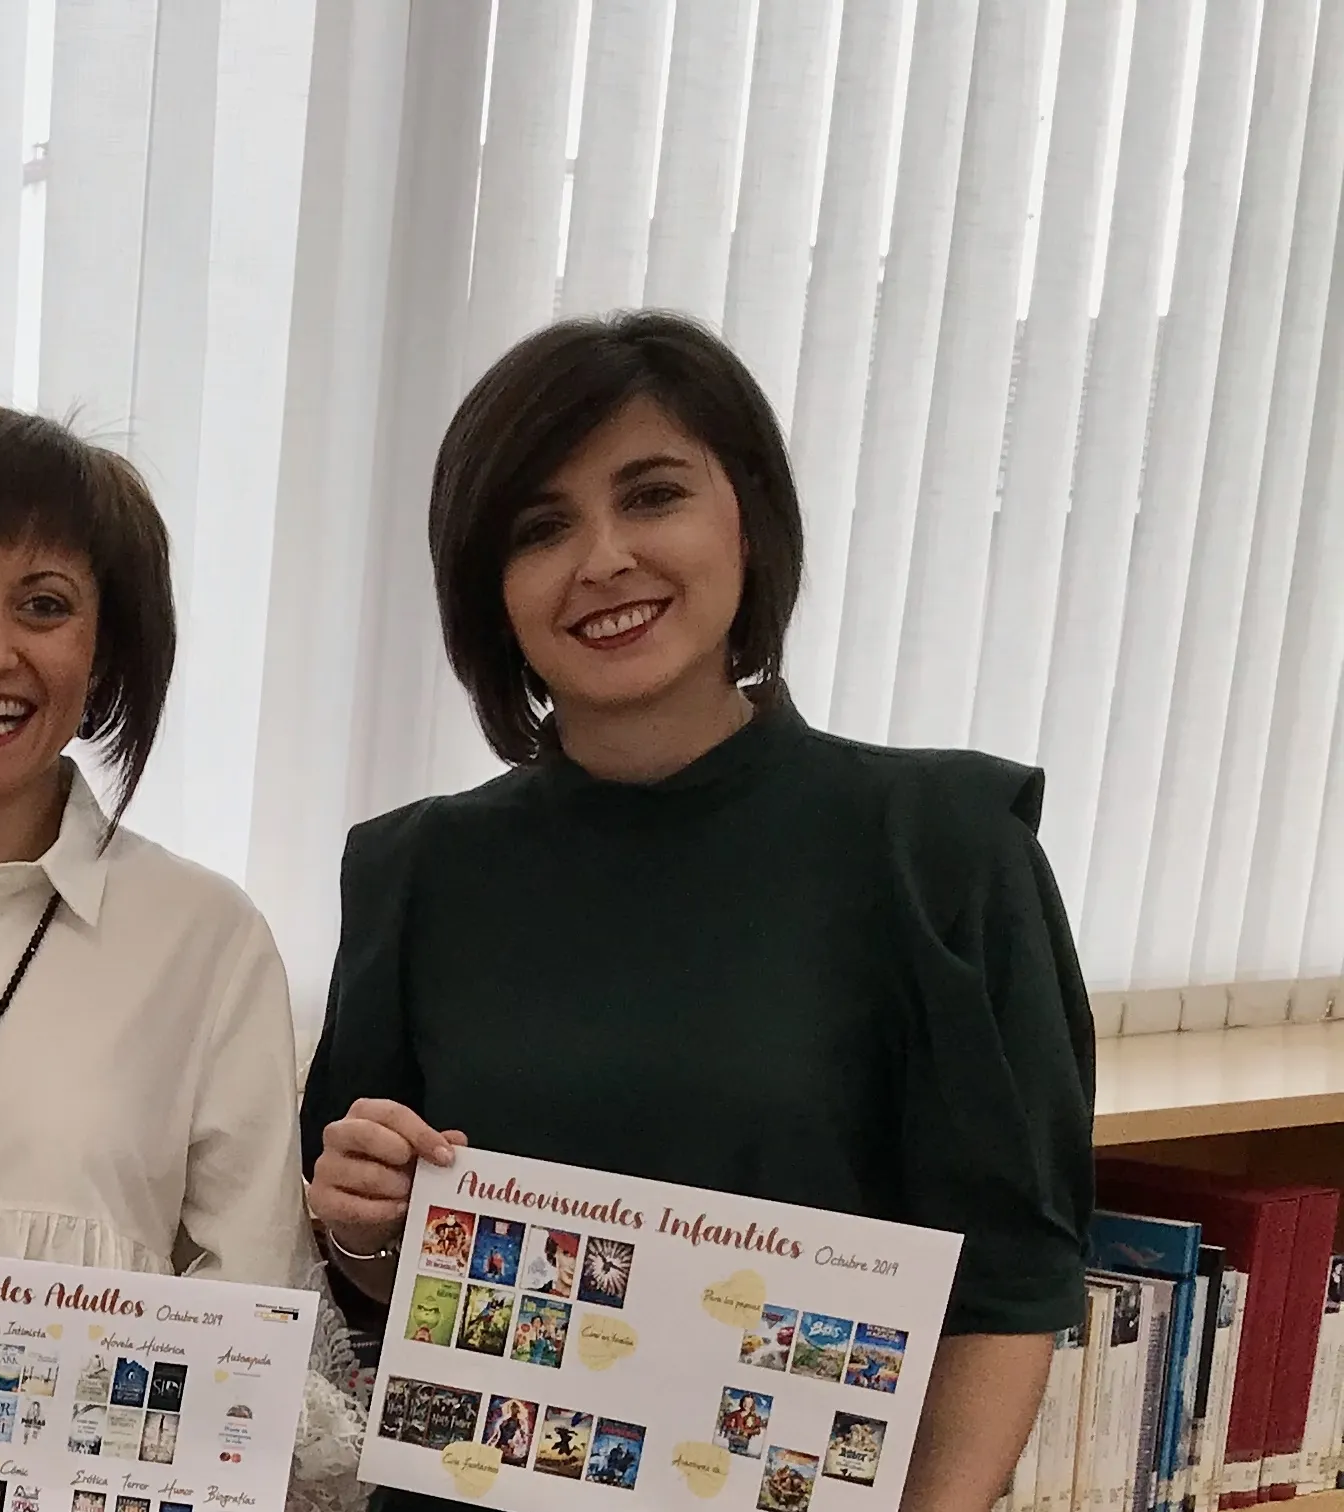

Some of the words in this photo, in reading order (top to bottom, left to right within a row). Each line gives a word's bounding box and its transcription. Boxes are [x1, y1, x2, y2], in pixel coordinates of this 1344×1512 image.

[456, 1170, 646, 1230] Audiovisuales
[655, 1206, 805, 1259] Infantiles
[814, 1245, 868, 1272] Octubre
[871, 1258, 900, 1277] 2019
[44, 1282, 146, 1318] Adultos
[156, 1304, 199, 1325] Octubre
[201, 1311, 224, 1327] 2019
[3, 1321, 47, 1339] Intimista
[158, 1479, 195, 1499] Humor
